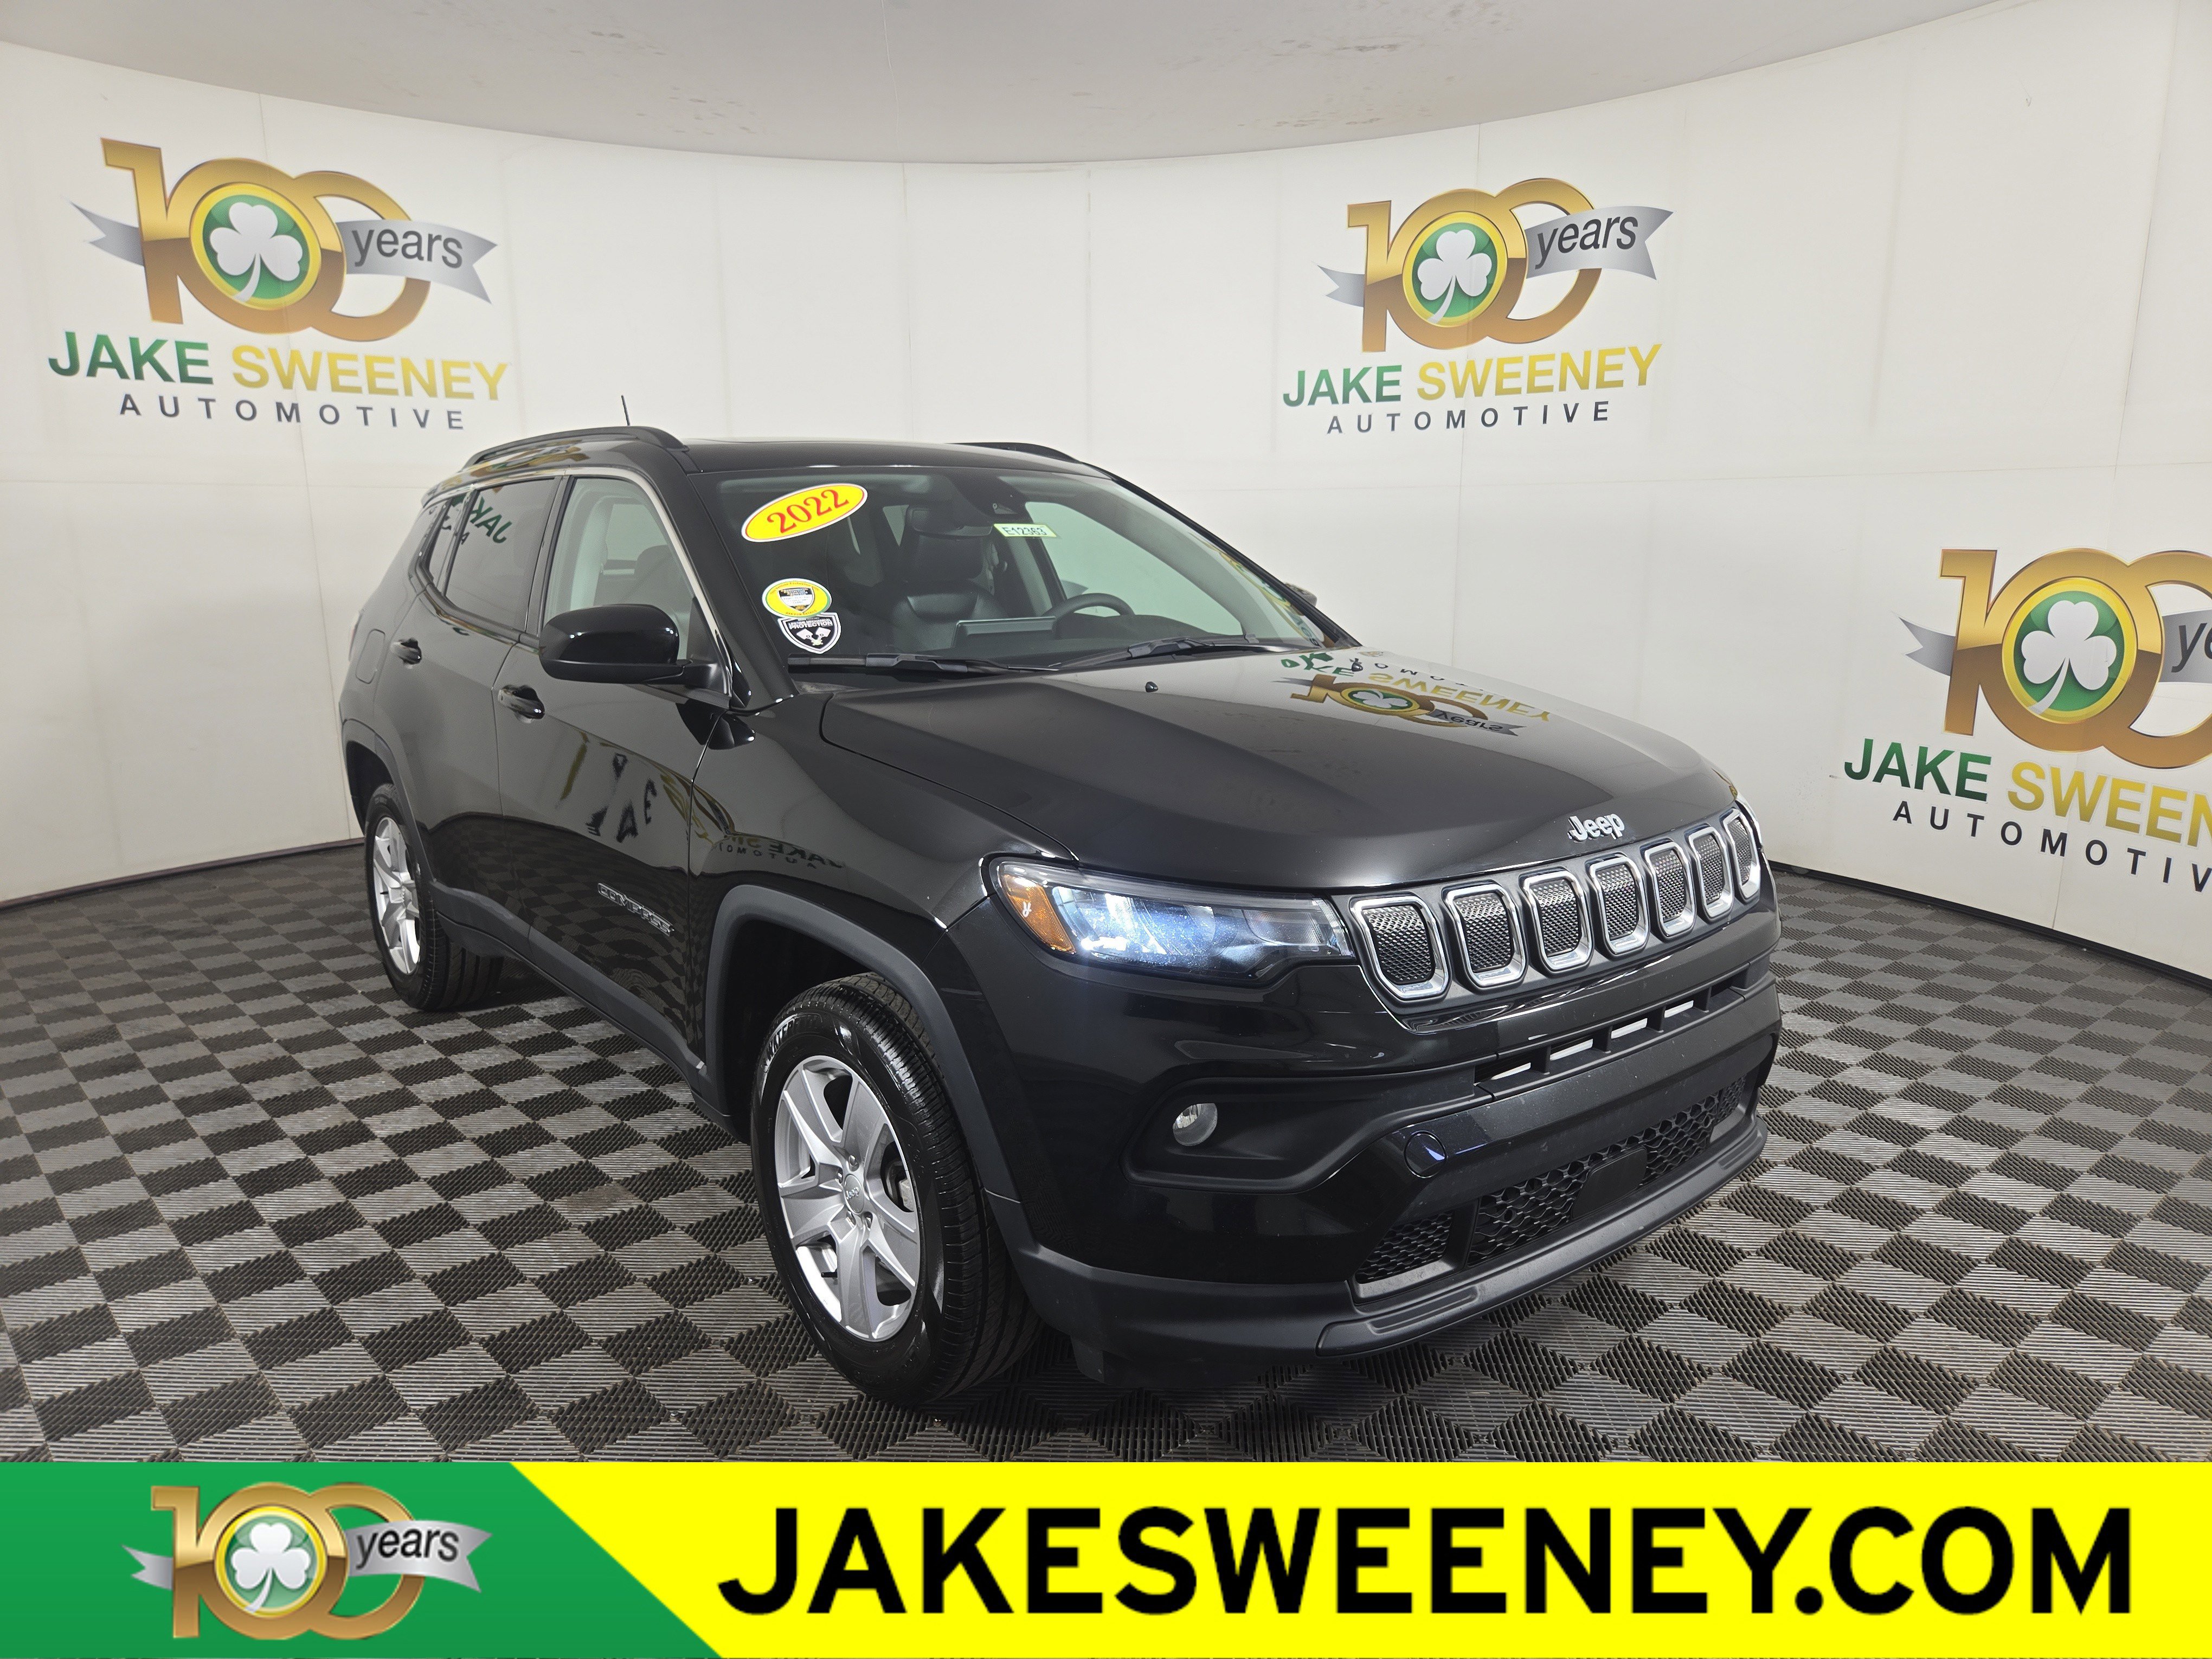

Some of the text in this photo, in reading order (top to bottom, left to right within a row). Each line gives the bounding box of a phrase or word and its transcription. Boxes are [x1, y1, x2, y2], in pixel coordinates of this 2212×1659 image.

[100, 137, 431, 342] 100
[351, 227, 464, 269] years
[1347, 177, 1603, 353] 100
[1534, 215, 1638, 270] years
[48, 331, 510, 401] JAKE SWEENEY
[1282, 344, 1663, 407] JAKE SWEENEY
[119, 394, 464, 430] AUTOMOTIVE
[1327, 401, 1610, 435] AUTOMOTIVE
[767, 489, 850, 533] 2022
[1001, 526, 1047, 536] E12363
[1844, 738, 2212, 848] JAKE SWEEN
[1568, 813, 1625, 841] Jeep
[1892, 800, 2212, 892] AUTOMOTIV
